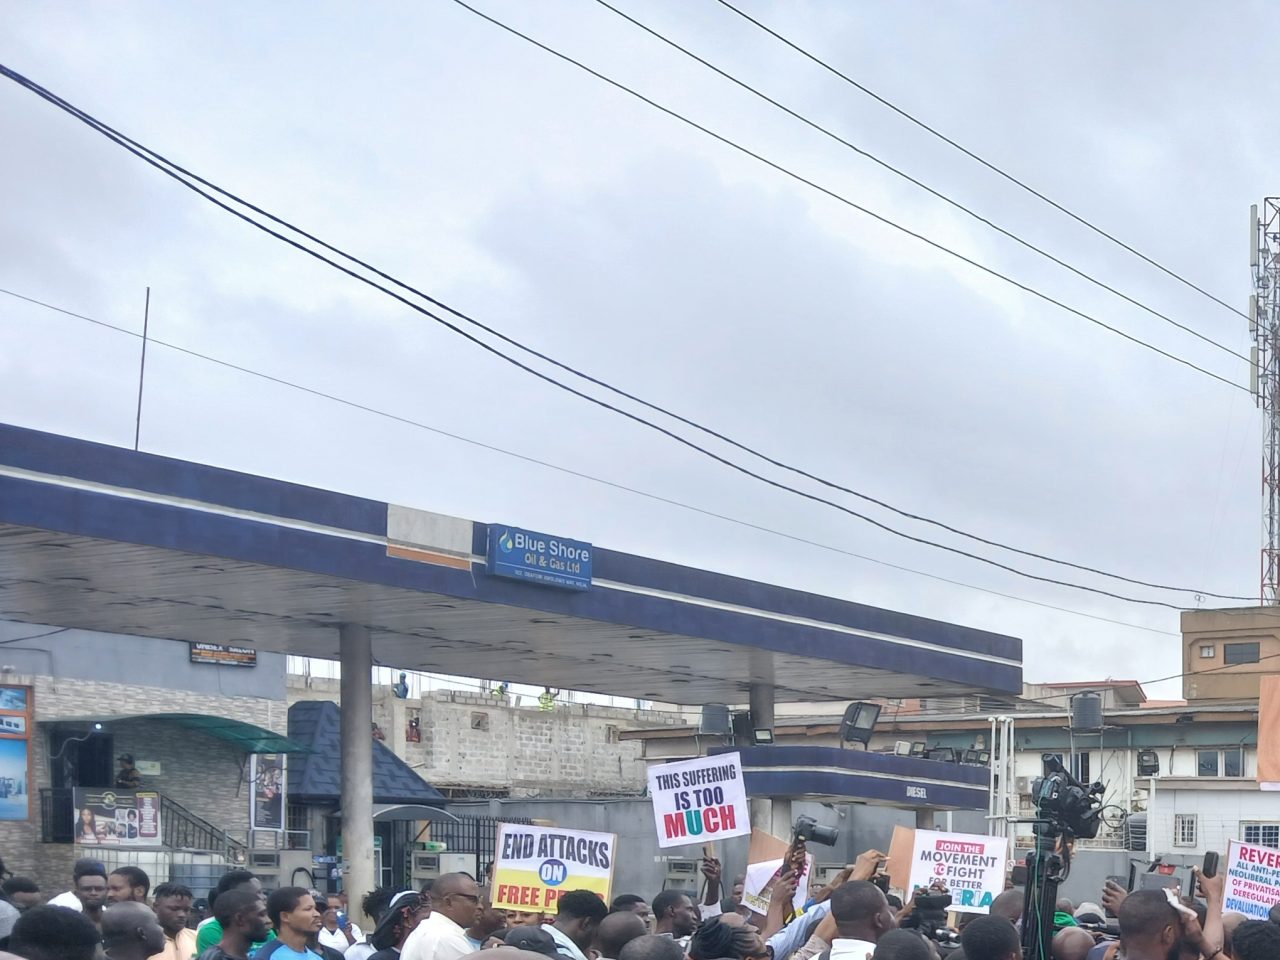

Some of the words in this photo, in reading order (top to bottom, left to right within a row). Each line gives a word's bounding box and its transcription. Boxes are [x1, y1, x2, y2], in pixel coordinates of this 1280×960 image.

[514, 534, 546, 552] Blue
[549, 540, 589, 562] Shore
[524, 553, 536, 565] Oil
[538, 556, 547, 567] &
[550, 559, 564, 571] Gas
[567, 561, 580, 574] Ltd
[656, 772, 680, 790] THIS
[682, 764, 736, 787] SUFFERING
[674, 791, 691, 810] IS
[693, 786, 724, 808] TOO
[664, 805, 736, 839] MUCH
[502, 834, 534, 860] END
[537, 834, 610, 869] ATTACKS
[939, 842, 961, 852] JOIN
[964, 844, 980, 853] THE
[921, 850, 997, 868] MOVEMENT
[1236, 861, 1249, 870] ALL
[541, 864, 564, 882] ON
[934, 864, 945, 874] TO
[946, 866, 985, 879] FIGHT
[1228, 868, 1272, 885] NEOLIBERAL
[929, 877, 947, 886] FOR
[950, 880, 982, 889] BETTER
[497, 884, 540, 906] FREE
[1226, 898, 1270, 918] DEVALUATION
